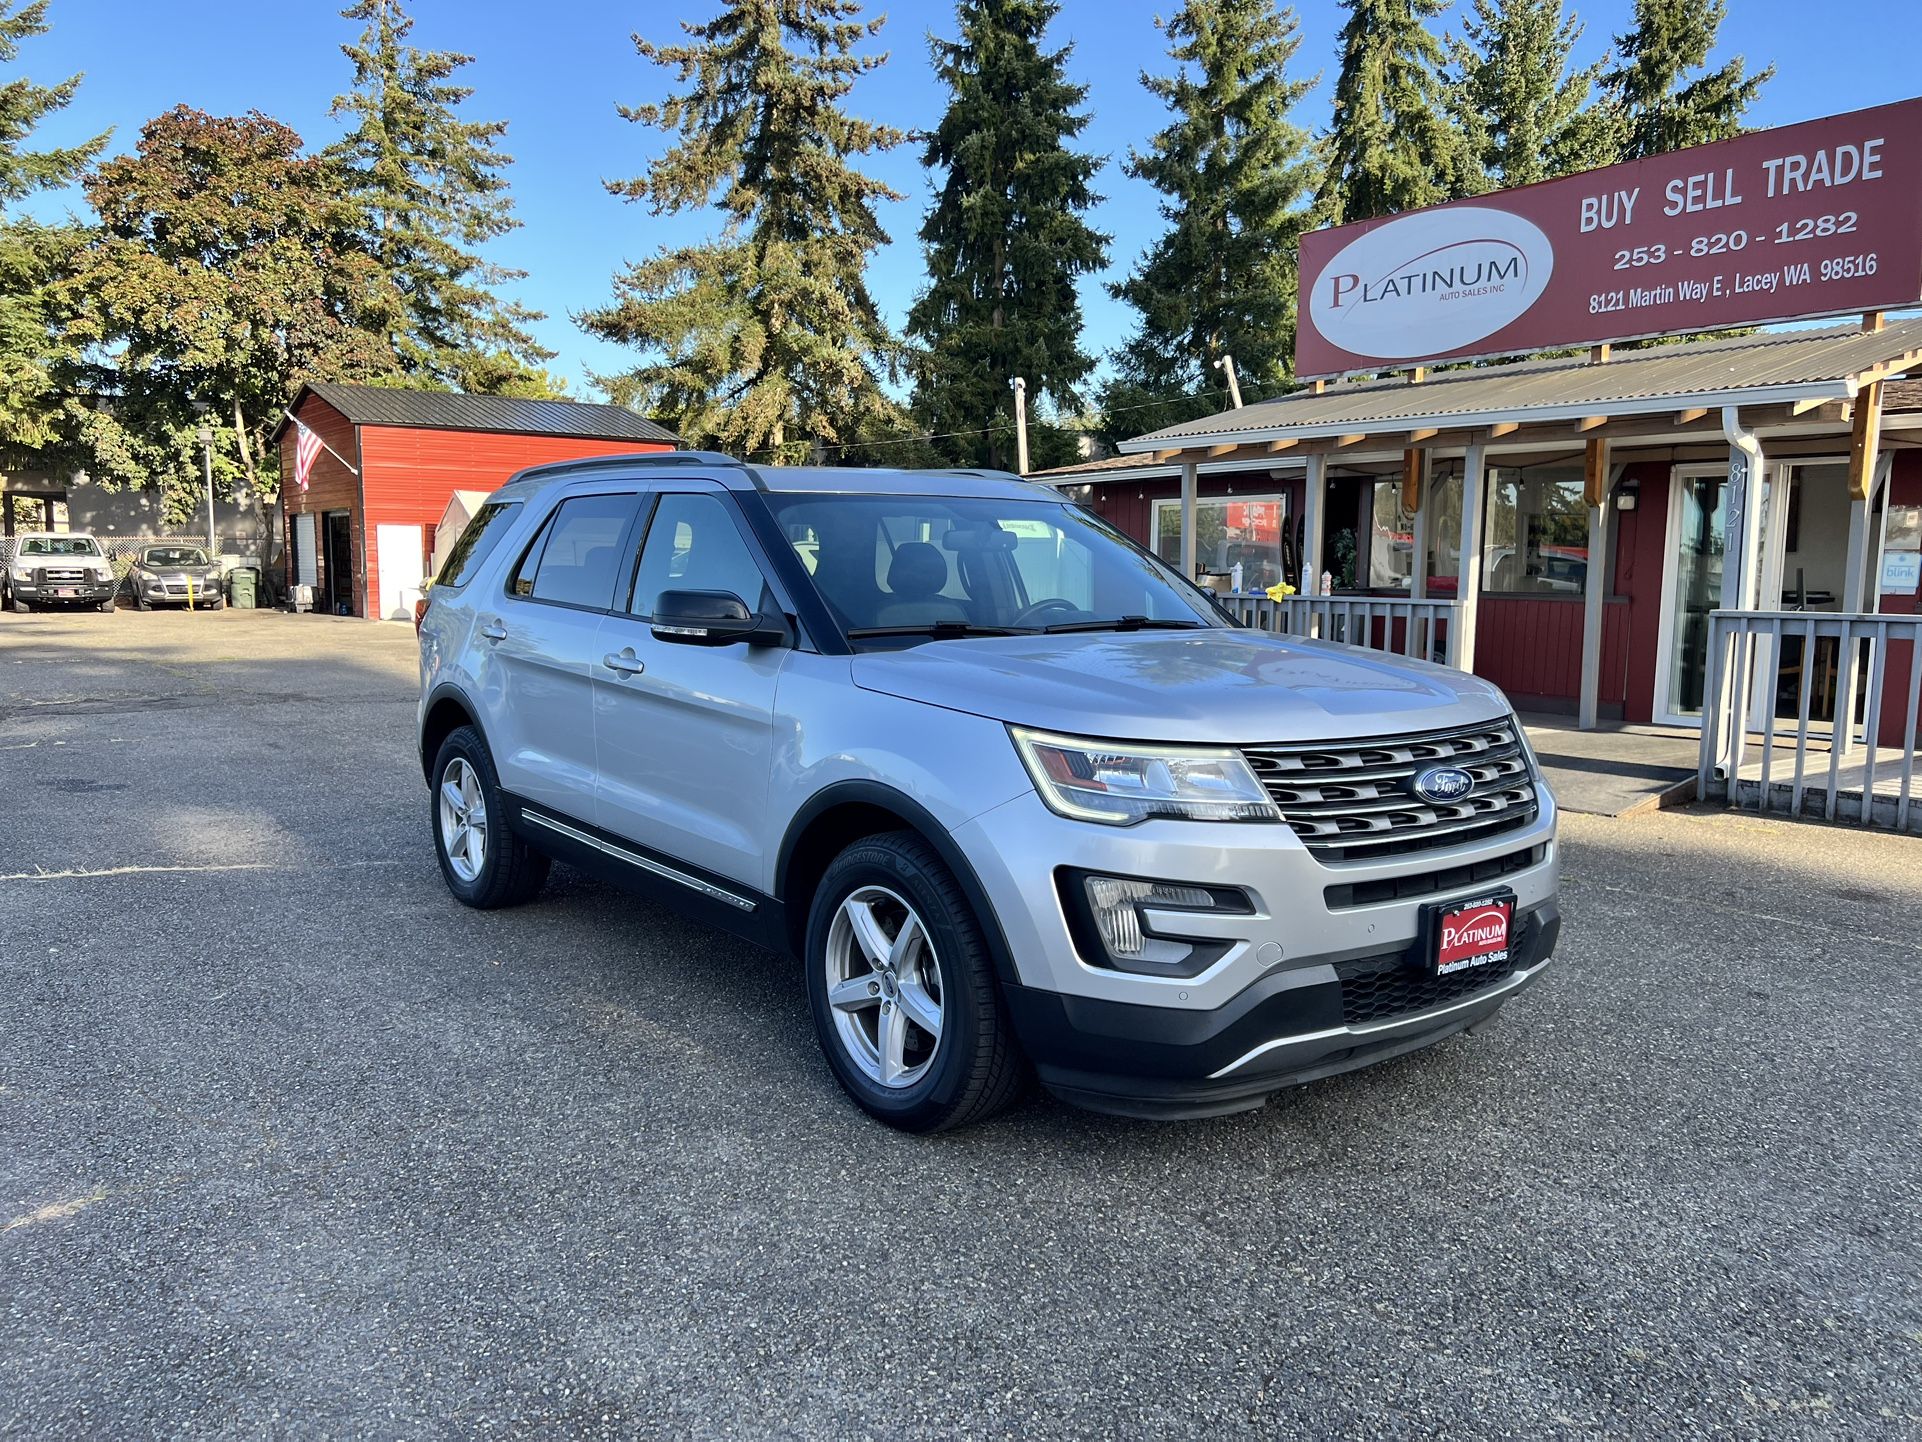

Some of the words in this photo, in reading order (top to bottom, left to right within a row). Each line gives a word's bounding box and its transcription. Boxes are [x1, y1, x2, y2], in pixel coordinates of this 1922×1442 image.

[1580, 188, 1640, 233] BUY
[1663, 168, 1743, 217] SELL
[1762, 138, 1885, 198] TRADE
[1613, 244, 1666, 270] 253
[1689, 230, 1748, 257] 820
[1774, 211, 1858, 244] 1282
[1328, 257, 1519, 309] PLATINUM
[1439, 291, 1460, 302] AUTO
[1461, 287, 1488, 298] SALES
[1489, 284, 1505, 294] INC
[1589, 290, 1626, 314] 8121
[1628, 284, 1674, 308] Martin
[1678, 280, 1709, 303] Way
[1712, 275, 1723, 297] E
[1735, 272, 1780, 293] Lacey
[1784, 263, 1811, 286] WA
[1820, 253, 1877, 281] 98516
[1886, 567, 1914, 577] blink
[1433, 772, 1469, 796] Ford
[1441, 924, 1505, 950] PLATINUM
[1437, 959, 1469, 976] Platinum
[1470, 955, 1487, 967] Auto
[1488, 950, 1508, 963] Sales
